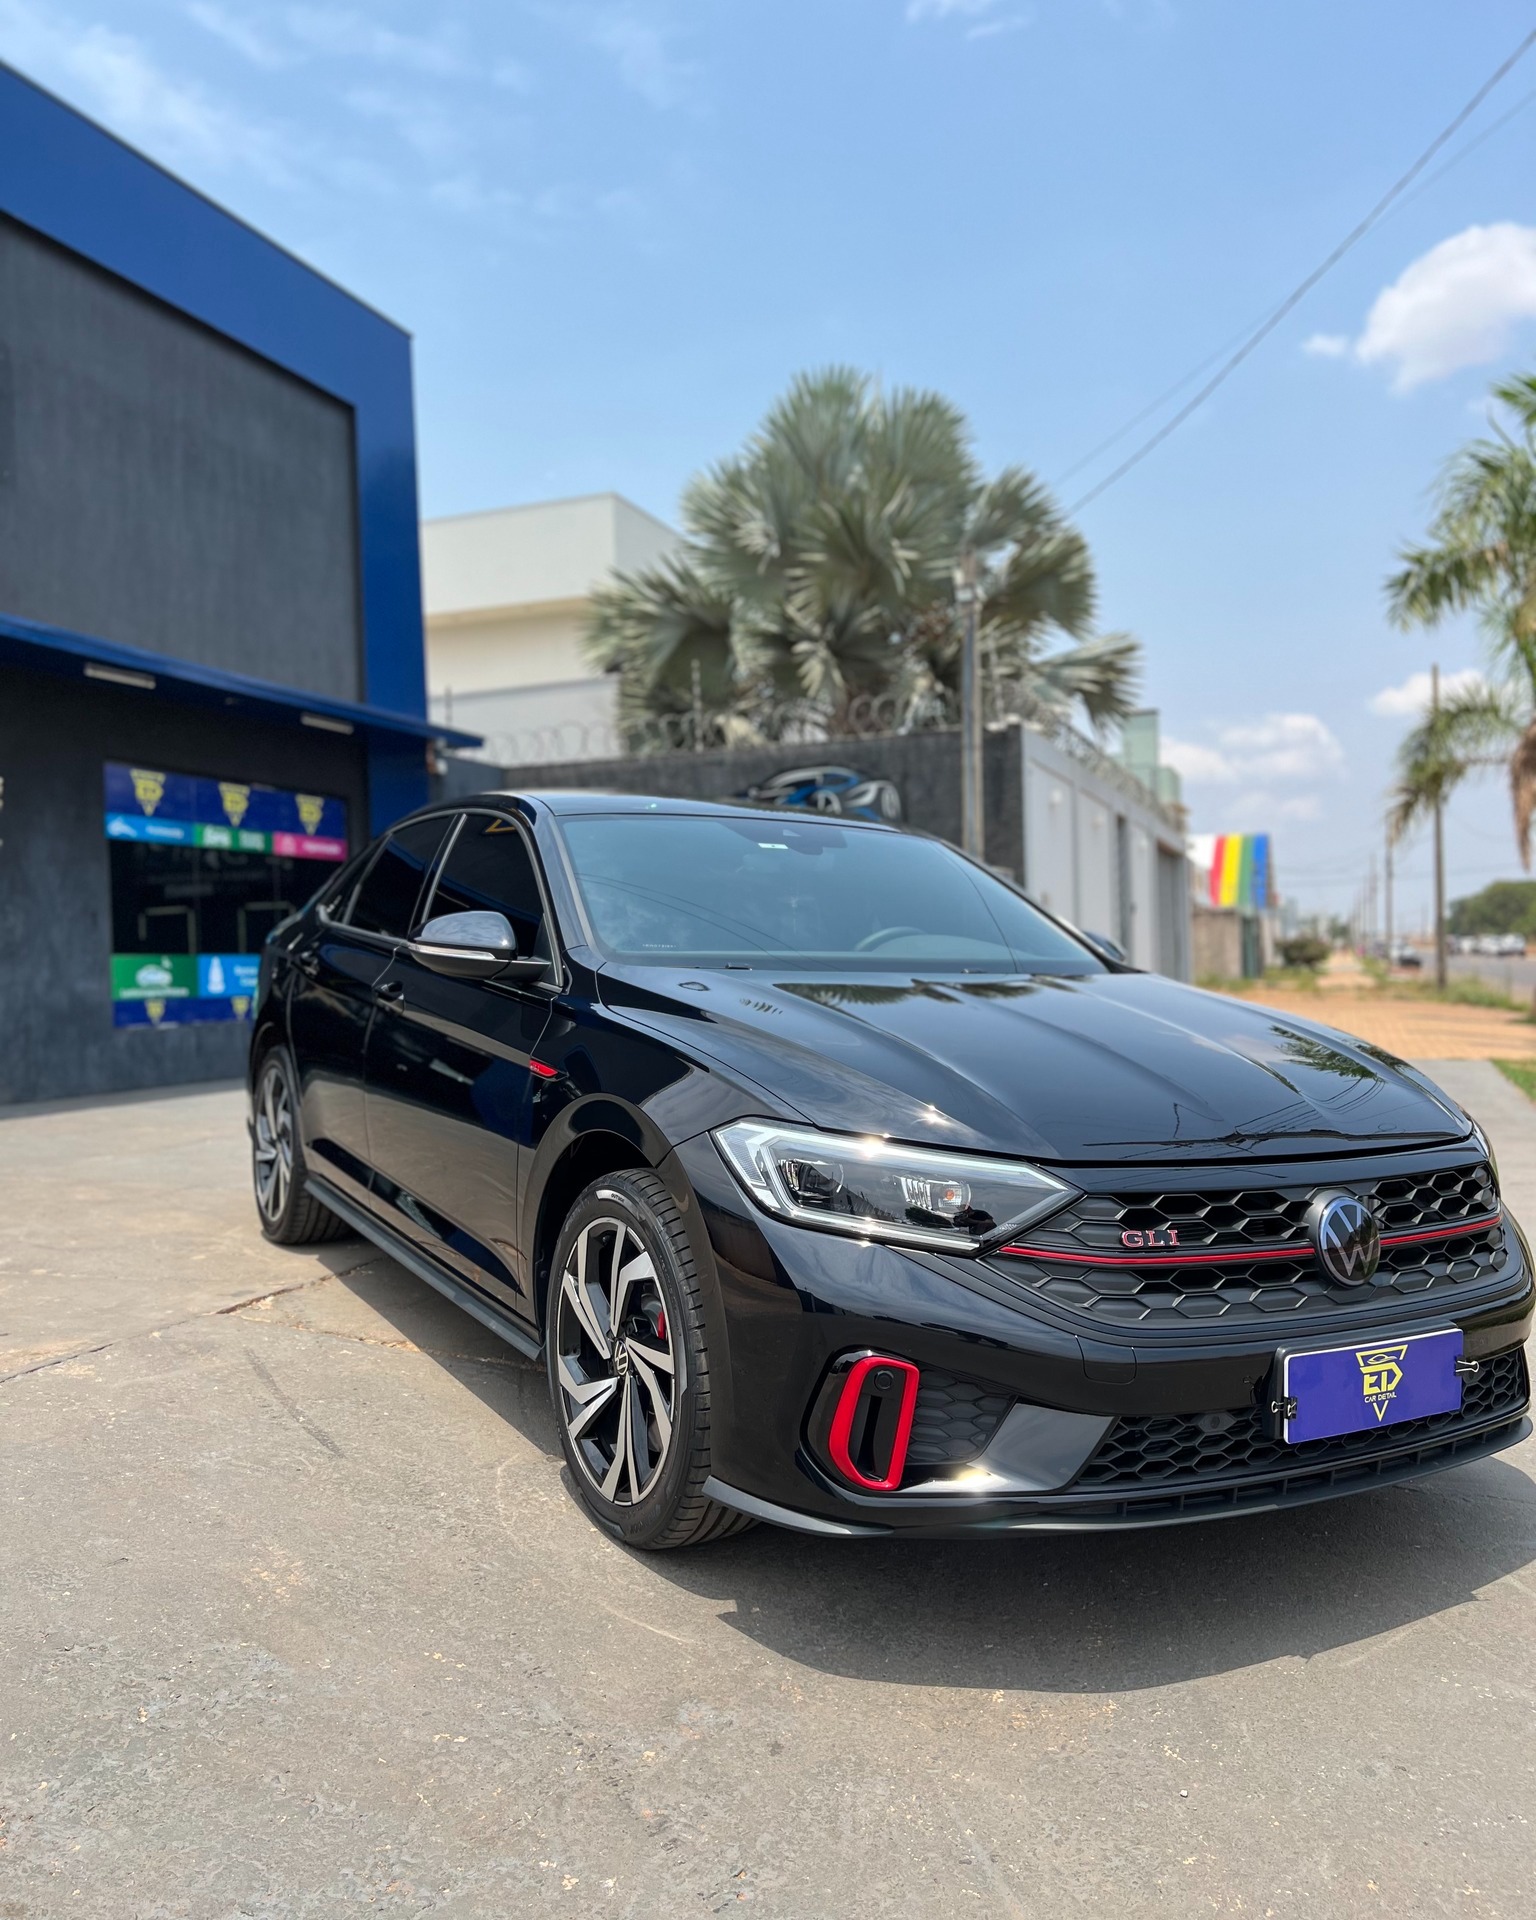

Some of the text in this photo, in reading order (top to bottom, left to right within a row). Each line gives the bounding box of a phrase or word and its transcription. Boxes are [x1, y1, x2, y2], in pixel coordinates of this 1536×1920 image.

[1121, 1229, 1180, 1247] GLI
[1320, 1197, 1381, 1287] VW
[1364, 1391, 1397, 1404] CAR DETAIL
